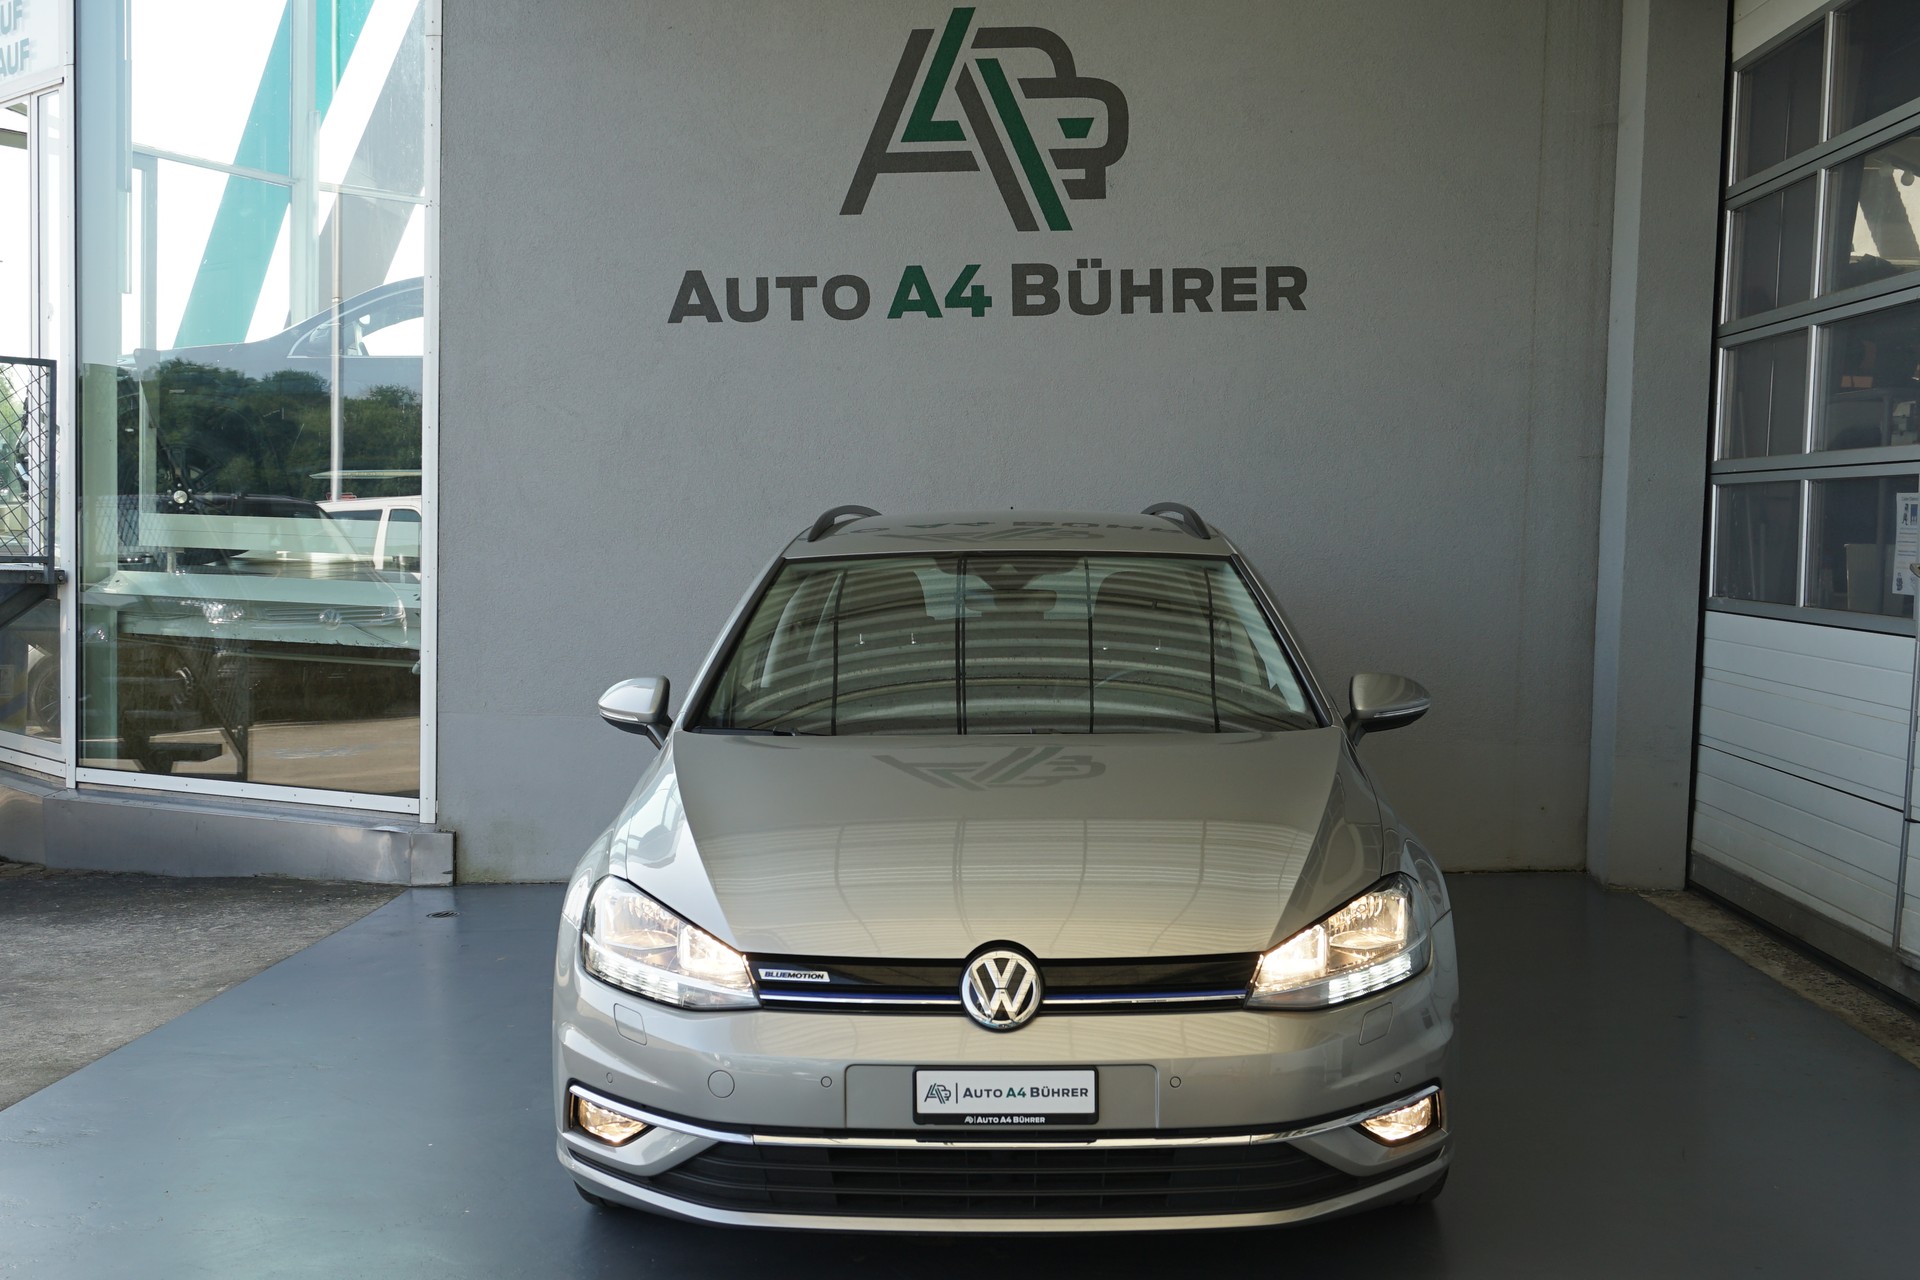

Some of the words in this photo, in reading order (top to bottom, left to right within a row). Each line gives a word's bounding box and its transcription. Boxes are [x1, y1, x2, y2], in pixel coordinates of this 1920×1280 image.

[667, 269, 871, 324] AUTO
[886, 264, 992, 319] A4
[1011, 258, 1308, 317] BÜHRER
[764, 970, 825, 980] BLUEMOTION
[963, 1087, 1003, 1099] AUTO
[1006, 1086, 1027, 1098] A4
[1030, 1085, 1089, 1098] BÜHRER
[976, 1115, 999, 1124] AUTO
[1000, 1115, 1012, 1124] A4
[1013, 1115, 1046, 1124] BÜHRER
